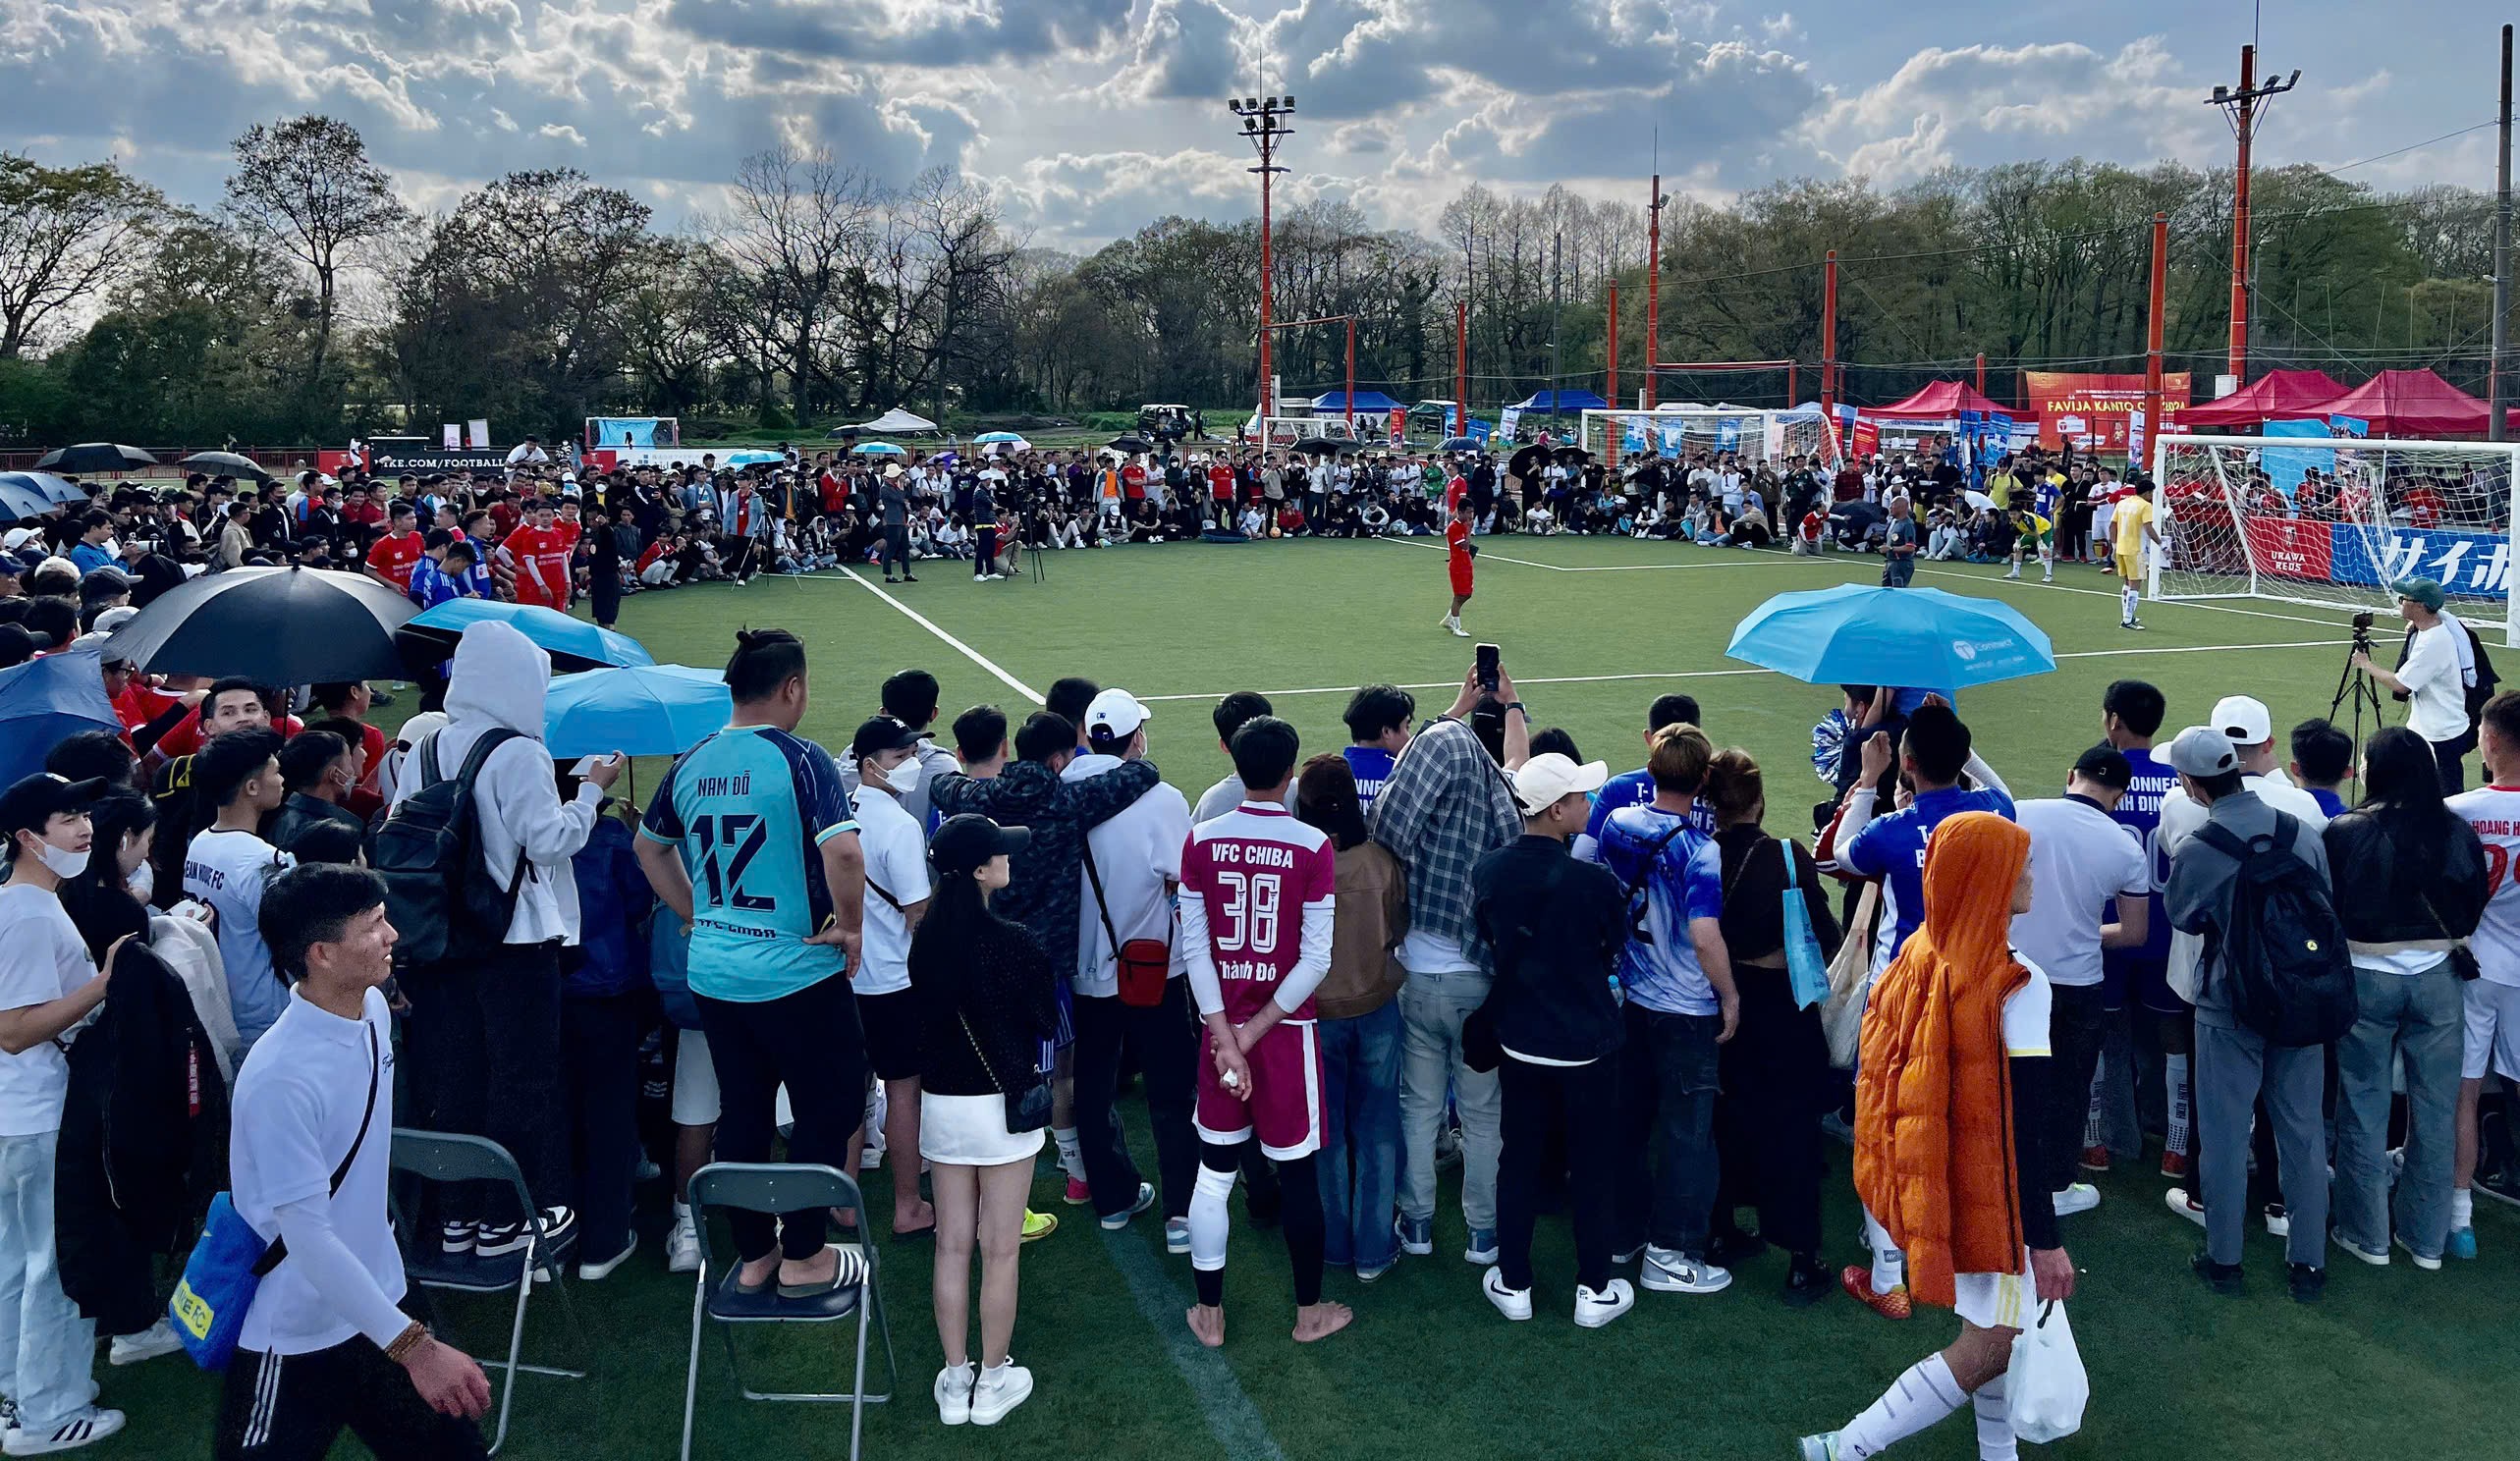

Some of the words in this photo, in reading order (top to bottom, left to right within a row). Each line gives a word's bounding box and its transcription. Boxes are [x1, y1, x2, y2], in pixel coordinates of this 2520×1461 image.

[2048, 401, 2092, 412] FAVIJA
[2095, 401, 2134, 412] KANTO
[2271, 551, 2306, 563] URAWA
[2275, 561, 2302, 571] REDS
[698, 777, 728, 797] NAM
[2126, 776, 2180, 792] ONNEC
[2138, 795, 2161, 816] ĐỊN
[689, 814, 777, 913] 12
[1212, 842, 1240, 863] VFC
[1244, 845, 1293, 869] CHIBA
[1217, 871, 1282, 954] 38
